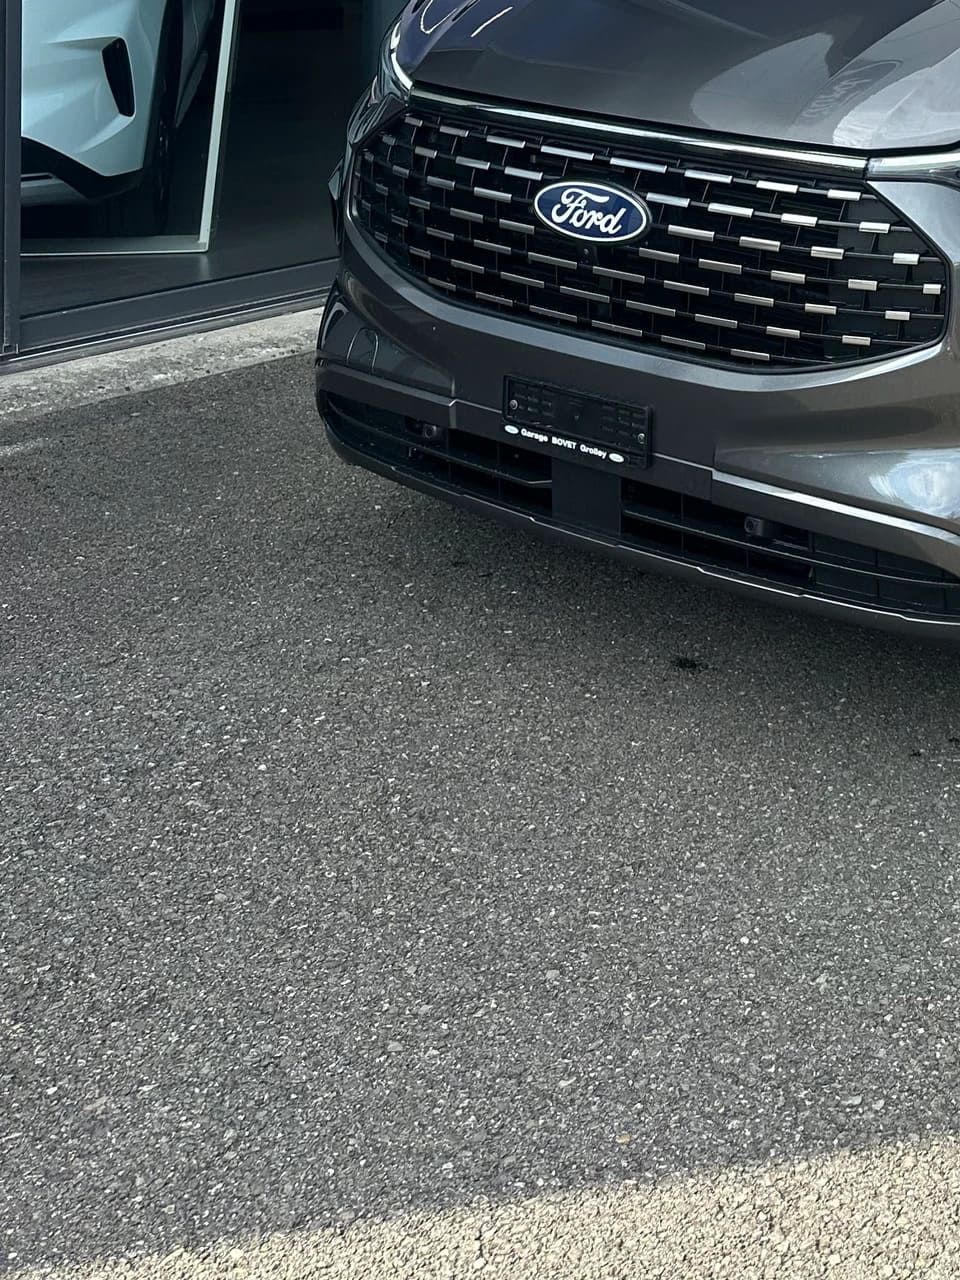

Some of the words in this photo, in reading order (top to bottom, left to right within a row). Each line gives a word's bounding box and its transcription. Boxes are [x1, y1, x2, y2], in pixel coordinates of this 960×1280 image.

[551, 188, 626, 235] Ford
[521, 428, 549, 442] Garage
[552, 436, 577, 450] BOVET
